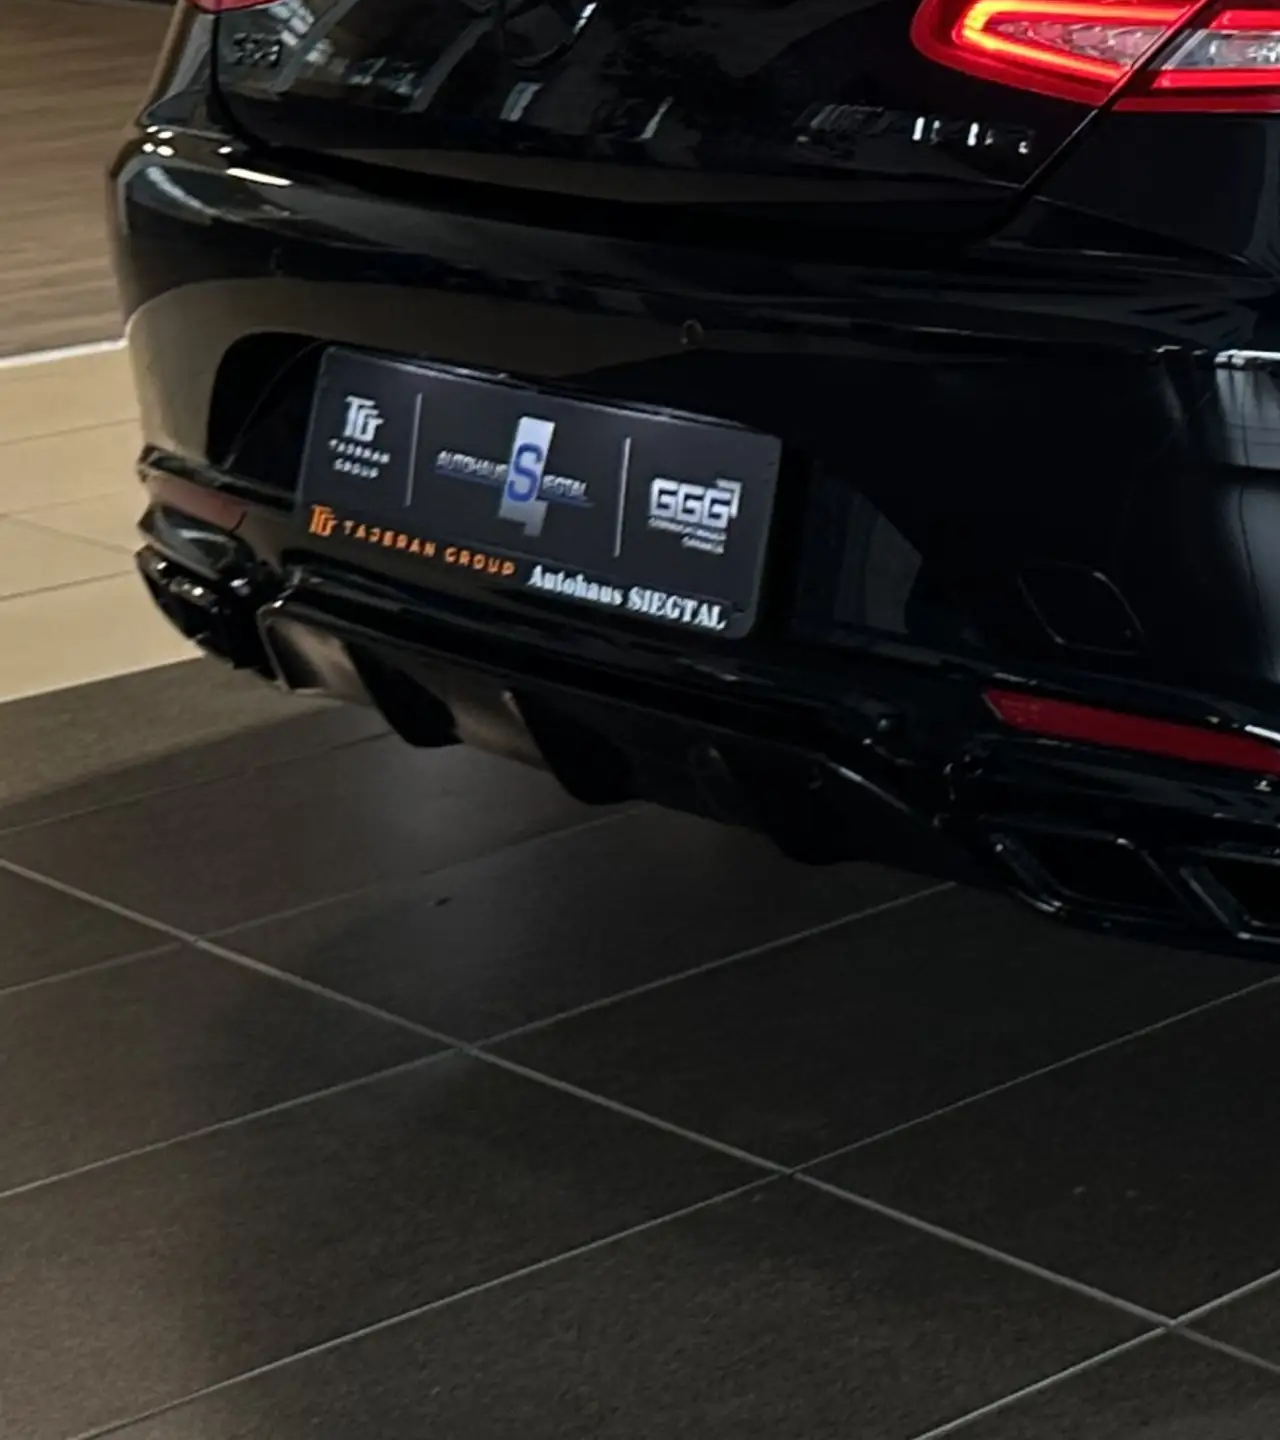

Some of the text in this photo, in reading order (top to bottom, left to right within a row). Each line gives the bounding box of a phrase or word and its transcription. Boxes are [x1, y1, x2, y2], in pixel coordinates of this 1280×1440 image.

[443, 546, 516, 577] GROUP
[526, 563, 728, 631] Autohaus SIEGTAL
